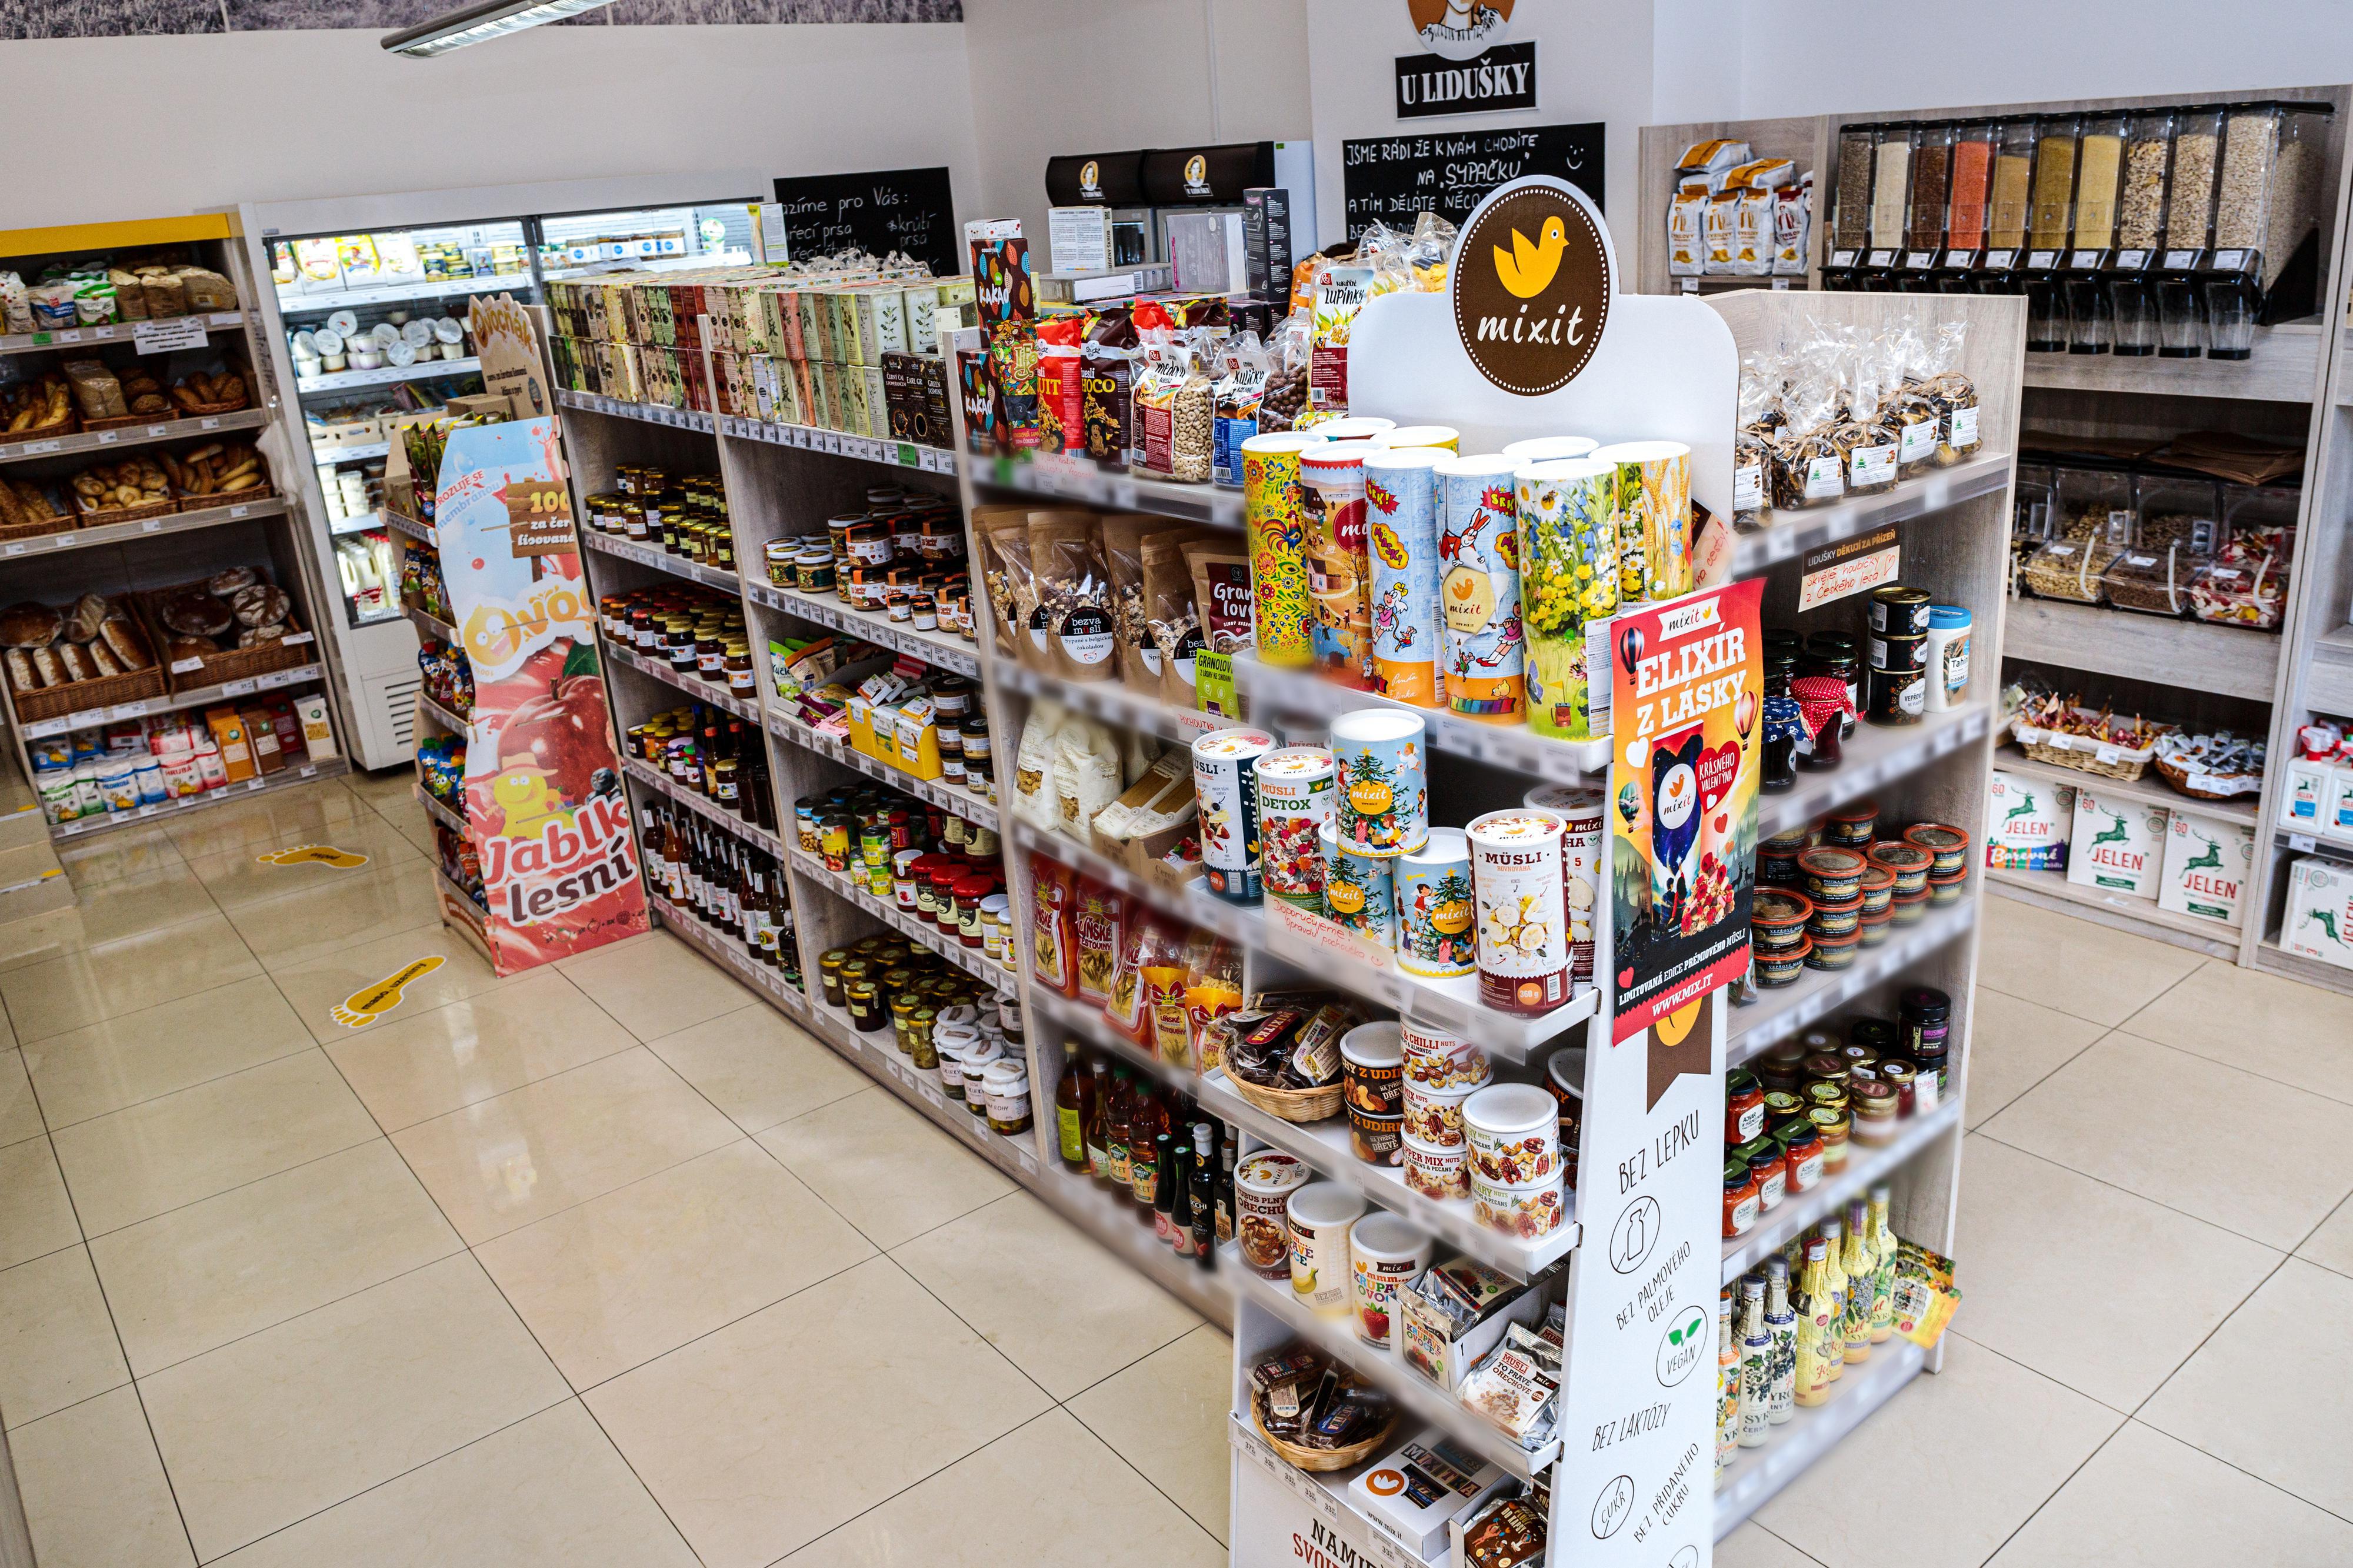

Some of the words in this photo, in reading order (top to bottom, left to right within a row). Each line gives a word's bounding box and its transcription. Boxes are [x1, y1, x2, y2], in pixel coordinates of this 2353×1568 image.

[1401, 74, 1419, 104] U
[1422, 58, 1530, 102] LIDUŠKY
[1347, 144, 1377, 166] JSME
[1382, 139, 1411, 161] RÁDI
[1414, 139, 1431, 157] ŽE
[1435, 143, 1444, 155] K
[1446, 135, 1476, 158] NÁM
[1417, 170, 1435, 186] NA
[839, 197, 864, 222] pro
[1348, 198, 1357, 212] A
[1361, 193, 1382, 212] TÍM
[1389, 191, 1435, 212] DĚLÁTE
[1445, 192, 1480, 209] NĚCO
[824, 223, 852, 245] prsa
[900, 233, 927, 252] prsa
[979, 283, 1009, 305] KAKAO
[1477, 304, 1585, 345] mixit
[906, 376, 916, 385] EARL
[965, 394, 992, 415] KAKAO
[435, 475, 472, 511] EROZLIJE
[472, 469, 487, 483] SE
[436, 479, 501, 529] membránou
[530, 519, 546, 529] za
[1808, 550, 1836, 567] LIDUŠKY
[1836, 541, 1862, 558] DĚKUJÍ
[1861, 538, 1871, 549] ZA
[1871, 529, 1896, 546] PŘÍZEŇ
[1843, 553, 1880, 574] houbičky
[1817, 578, 1855, 599] Českého
[1860, 572, 1879, 588] lesa
[1448, 604, 1481, 615] mixit
[1072, 617, 1101, 626] bezva
[1073, 623, 1102, 634] müsli
[1669, 609, 1700, 631] mixit
[1076, 642, 1104, 650] čokoládou
[1635, 622, 1747, 699] ELIXÍR
[1637, 706, 1654, 738] Z
[1661, 669, 1747, 729] LÁSKY
[1179, 713, 1214, 731] POCHOUTKA
[1699, 752, 1735, 780] KRÁSNÉHO
[1261, 783, 1296, 795] MÜSLI
[1701, 769, 1732, 793] VALENTÝNA
[1992, 784, 2005, 794] 60
[1352, 789, 1388, 800] mixit
[2079, 788, 2084, 796] 3
[2297, 792, 2314, 800] JELEN
[1262, 796, 1311, 810] DETOX
[1663, 793, 1692, 816] mixit
[2082, 799, 2095, 809] 60
[1325, 812, 1329, 820] 6
[2005, 821, 2048, 835] JELEN
[2175, 822, 2188, 834] 60
[1485, 852, 1541, 865] MÜSLI
[1574, 858, 1581, 866] 5
[2092, 847, 2144, 870] JELEN
[509, 833, 636, 925] lesní
[2184, 872, 2237, 899] JELEN
[1329, 890, 1359, 900] mixit
[1435, 905, 1469, 919] mixit
[389, 962, 427, 988] uzeniny
[1618, 973, 1664, 1006] LIMITOVANÁ
[1664, 963, 1684, 982] EDICE
[1684, 940, 1726, 971] PRÉMIOVÉHO
[1726, 928, 1746, 948] MÜSLI
[1652, 973, 1714, 1017] WWW.MIX.IT
[1409, 1033, 1439, 1050] CHILLI
[1411, 1044, 1432, 1055] ALMONDS
[1359, 1067, 1368, 1077] Z
[1408, 1097, 1421, 1110] PECANS
[1415, 1095, 1428, 1103] NUTS
[1354, 1116, 1360, 1126] Z
[1743, 1112, 1757, 1122] AJVAR
[1474, 1139, 1491, 1150] PECANS
[1478, 1132, 1491, 1140] NUTS
[1425, 1155, 1444, 1166] MIX
[1618, 1148, 1647, 1195] BEZ
[1656, 1109, 1699, 1169] LEPKU
[1111, 1165, 1126, 1174] OCET
[1802, 1162, 1815, 1173] AJVAR
[1494, 1189, 1508, 1198] NUTS
[1765, 1180, 1778, 1191] AJVAR
[1237, 1186, 1259, 1203] TUBUS
[1261, 1194, 1287, 1205] PLNÝ
[1238, 1195, 1286, 1215] OŘECHŮ
[1488, 1196, 1508, 1207] PECANS
[1738, 1204, 1751, 1215] AJVAR
[1616, 1297, 1635, 1331] BEZ
[1637, 1240, 1691, 1310] PALMOVÉHO
[1648, 1284, 1676, 1323] OLEJE
[1406, 1323, 1442, 1354] KŘUPAVÉ
[1407, 1331, 1435, 1356] OVOCE
[1498, 1362, 1508, 1371] TO
[1667, 1344, 1697, 1376] VEGAN
[1592, 1421, 1616, 1452] BEZ
[1619, 1401, 1671, 1442] LAKTÓZY
[1401, 1443, 1482, 1499] MIXITKA
[1634, 1515, 1653, 1543] BEZ
[1652, 1443, 1699, 1516] PŘIDANÉHO
[1601, 1490, 1626, 1524] CUKR
[1662, 1484, 1689, 1526] CUKRU
[1366, 1510, 1402, 1540] www.mix.it
